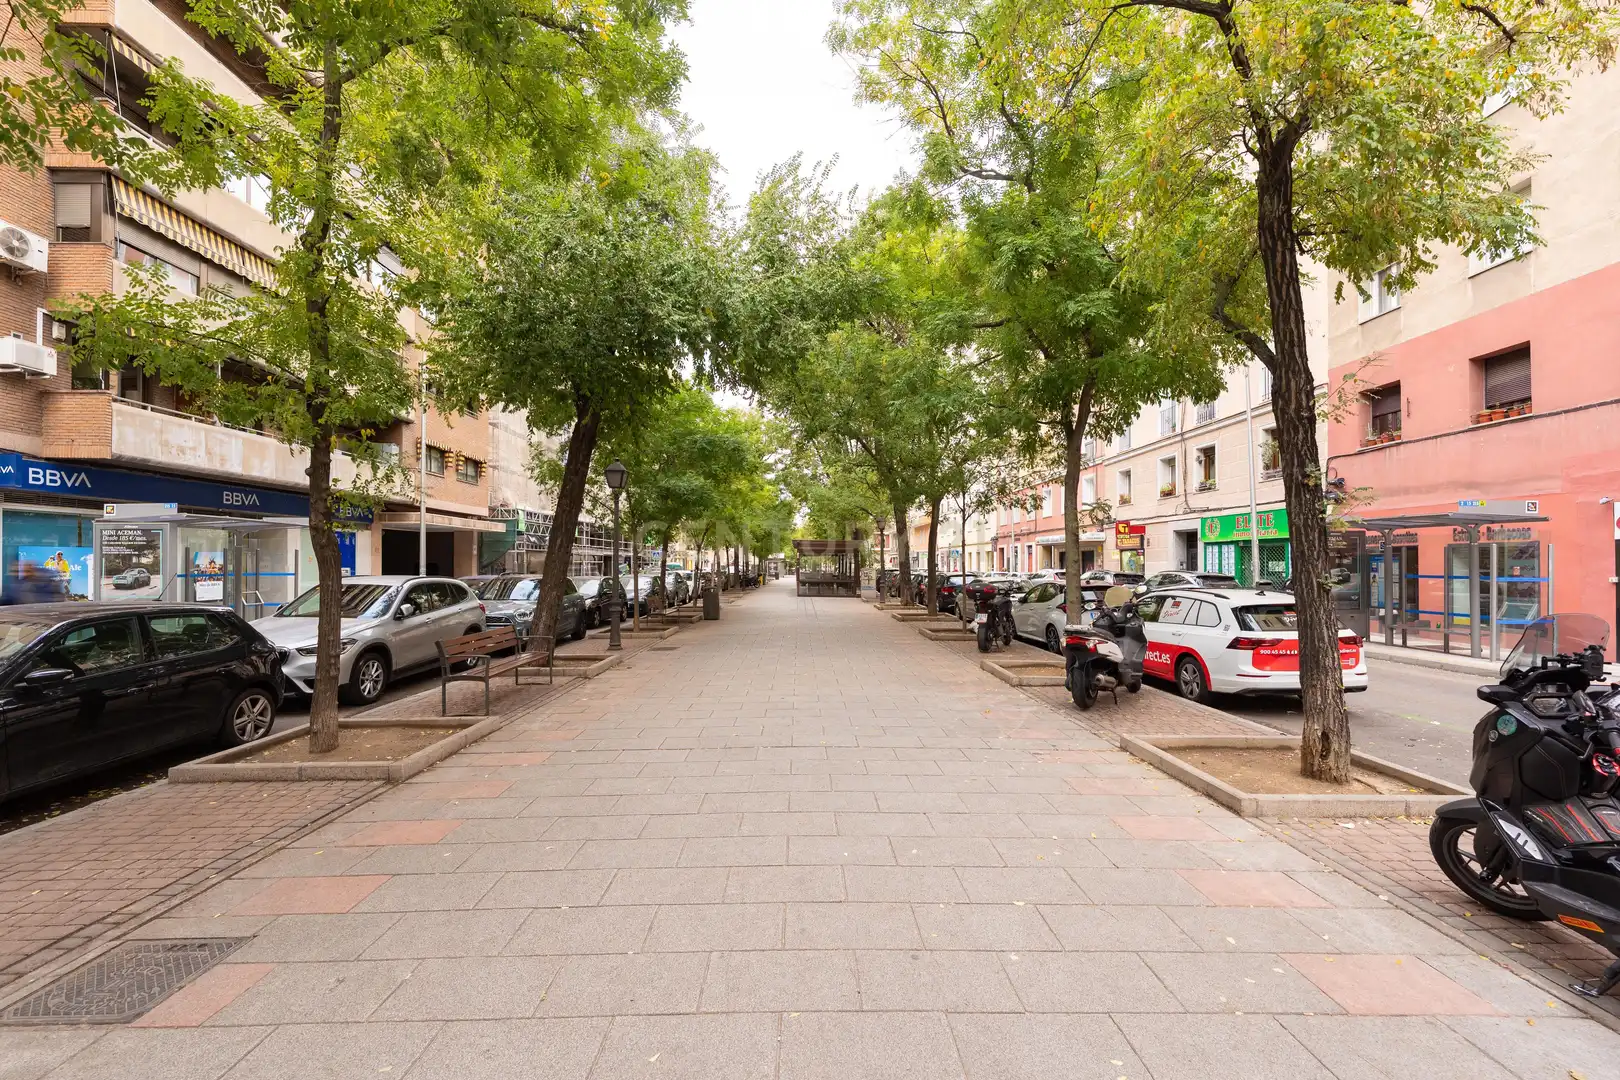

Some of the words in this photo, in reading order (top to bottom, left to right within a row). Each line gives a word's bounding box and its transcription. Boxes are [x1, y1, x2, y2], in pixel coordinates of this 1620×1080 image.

[28, 467, 92, 488] BBVA
[223, 491, 260, 506] BBVA
[1235, 513, 1275, 529] ELTE
